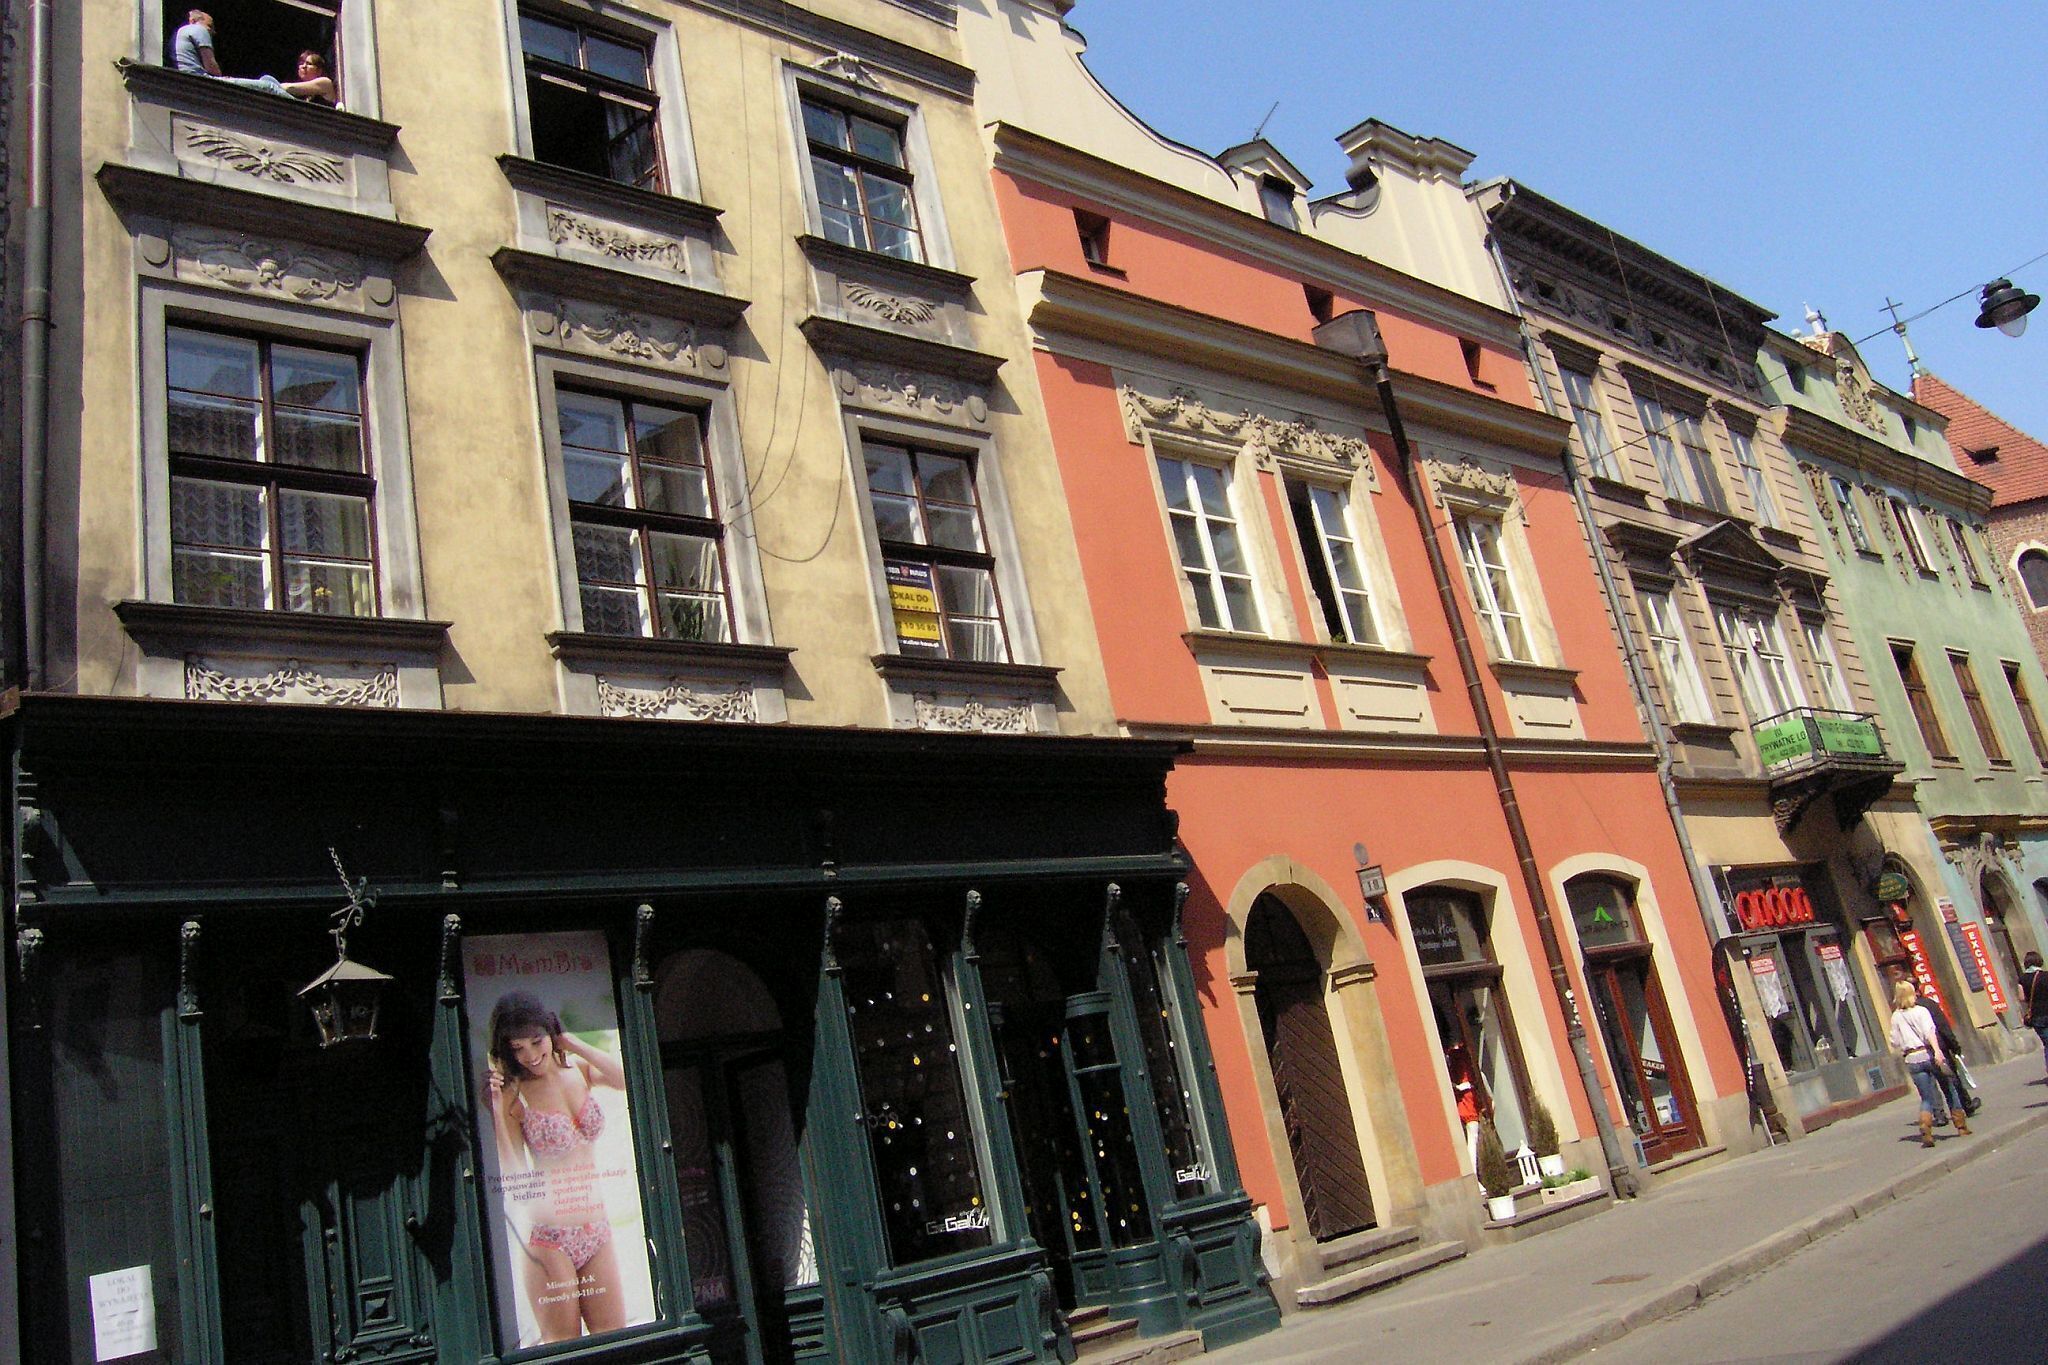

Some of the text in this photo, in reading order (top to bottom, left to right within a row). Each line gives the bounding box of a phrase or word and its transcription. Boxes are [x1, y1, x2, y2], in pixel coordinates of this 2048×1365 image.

[917, 595, 929, 603] DO
[1760, 734, 1796, 752] PRYWATNE
[1967, 931, 2000, 1002] EXCHANGE
[487, 1170, 545, 1182] Profesjonalne
[491, 1181, 546, 1194] dopasowanie
[513, 1191, 546, 1201] bielizny
